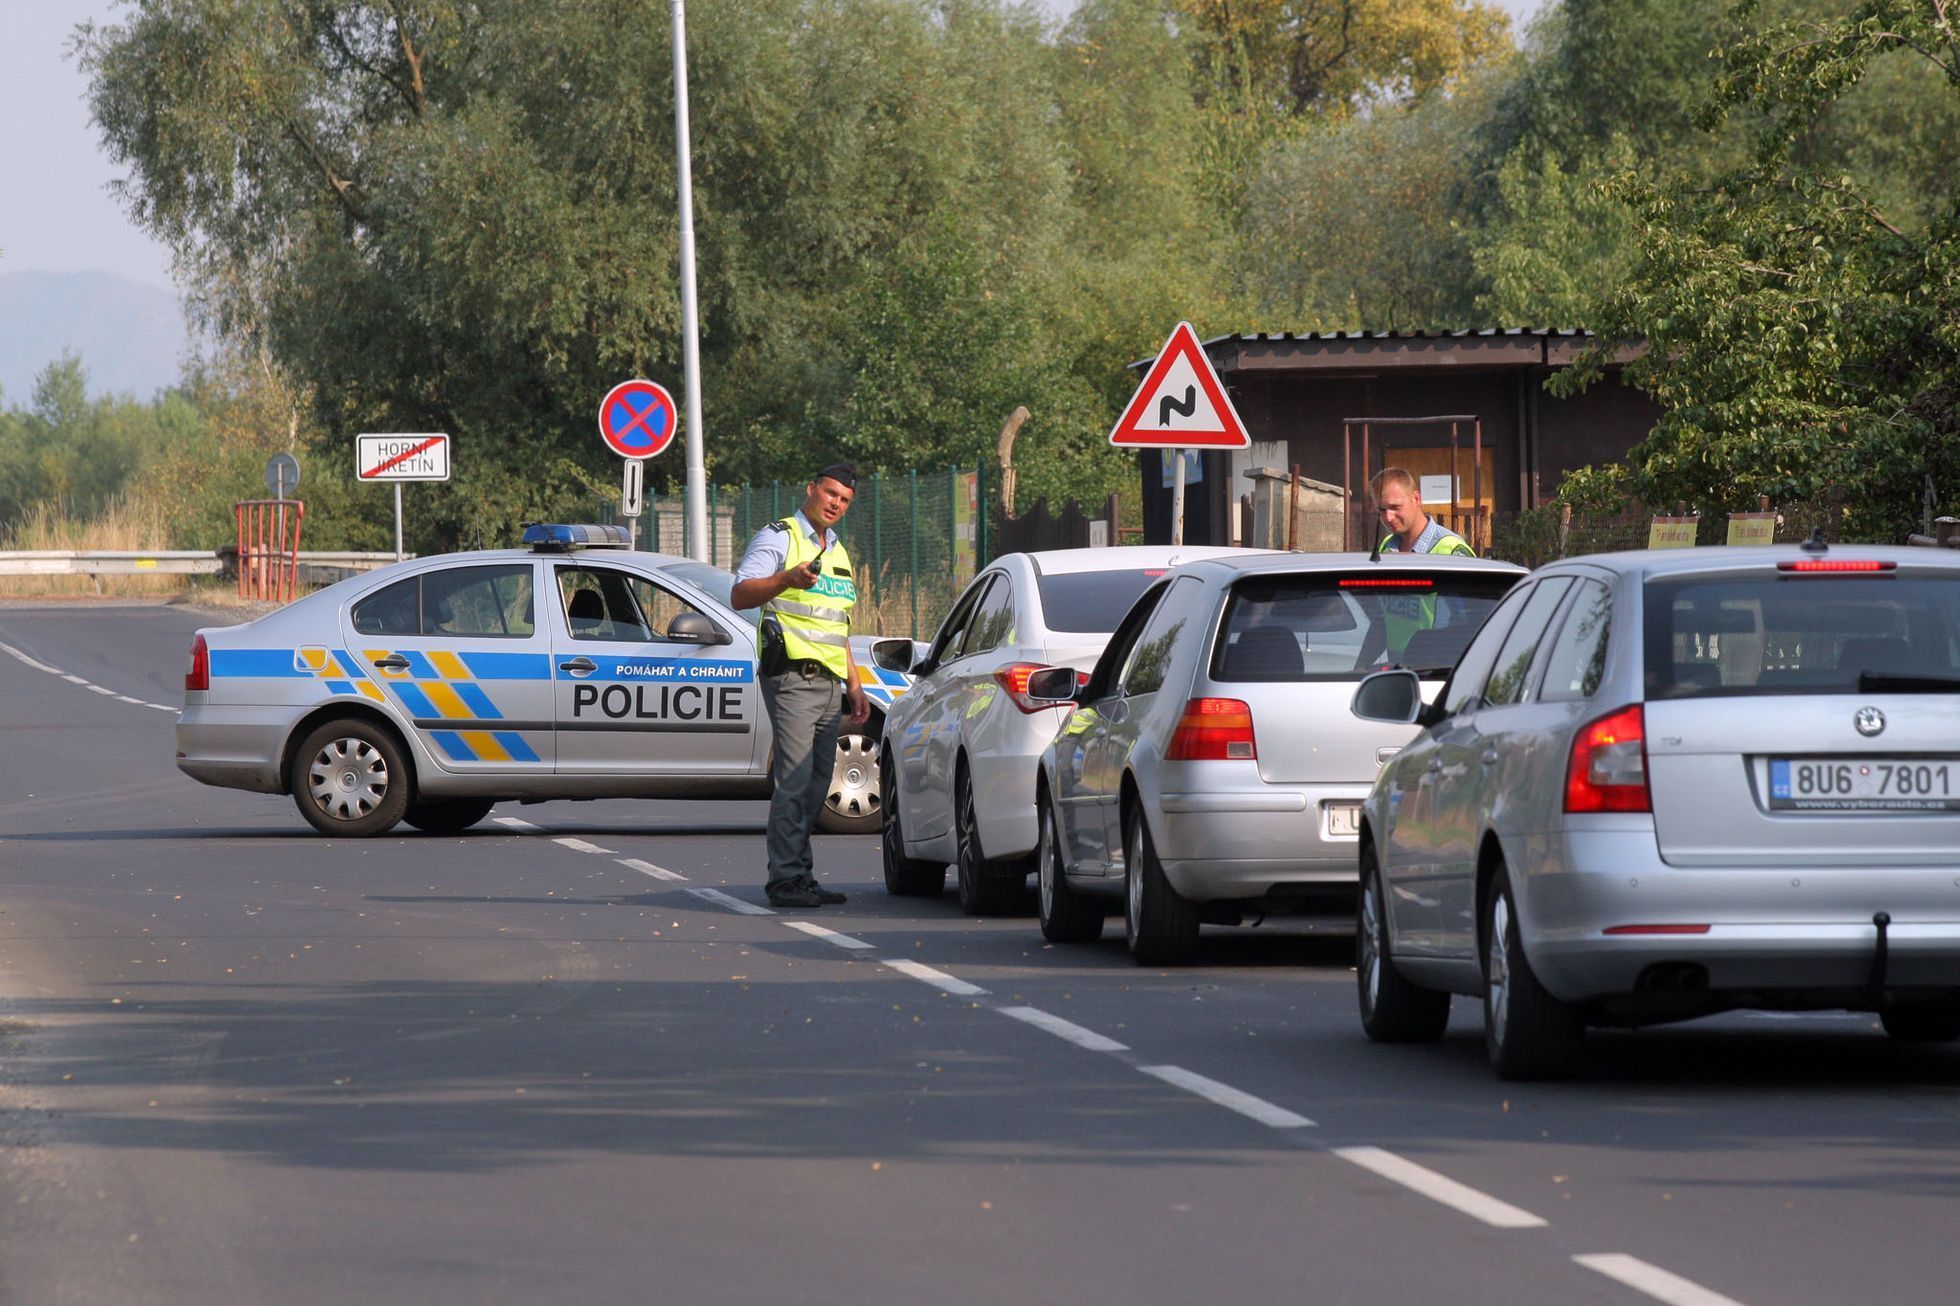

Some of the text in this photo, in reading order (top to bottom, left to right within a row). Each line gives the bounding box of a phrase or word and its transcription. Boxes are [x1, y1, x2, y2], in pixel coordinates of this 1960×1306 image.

[378, 440, 429, 456] HORNÍ
[377, 456, 434, 473] JIŘETÍN
[616, 664, 744, 678] POMÁHAT A CHRÁNIT
[573, 684, 743, 720] POLICIE
[1797, 765, 1950, 795] 8U6 7801
